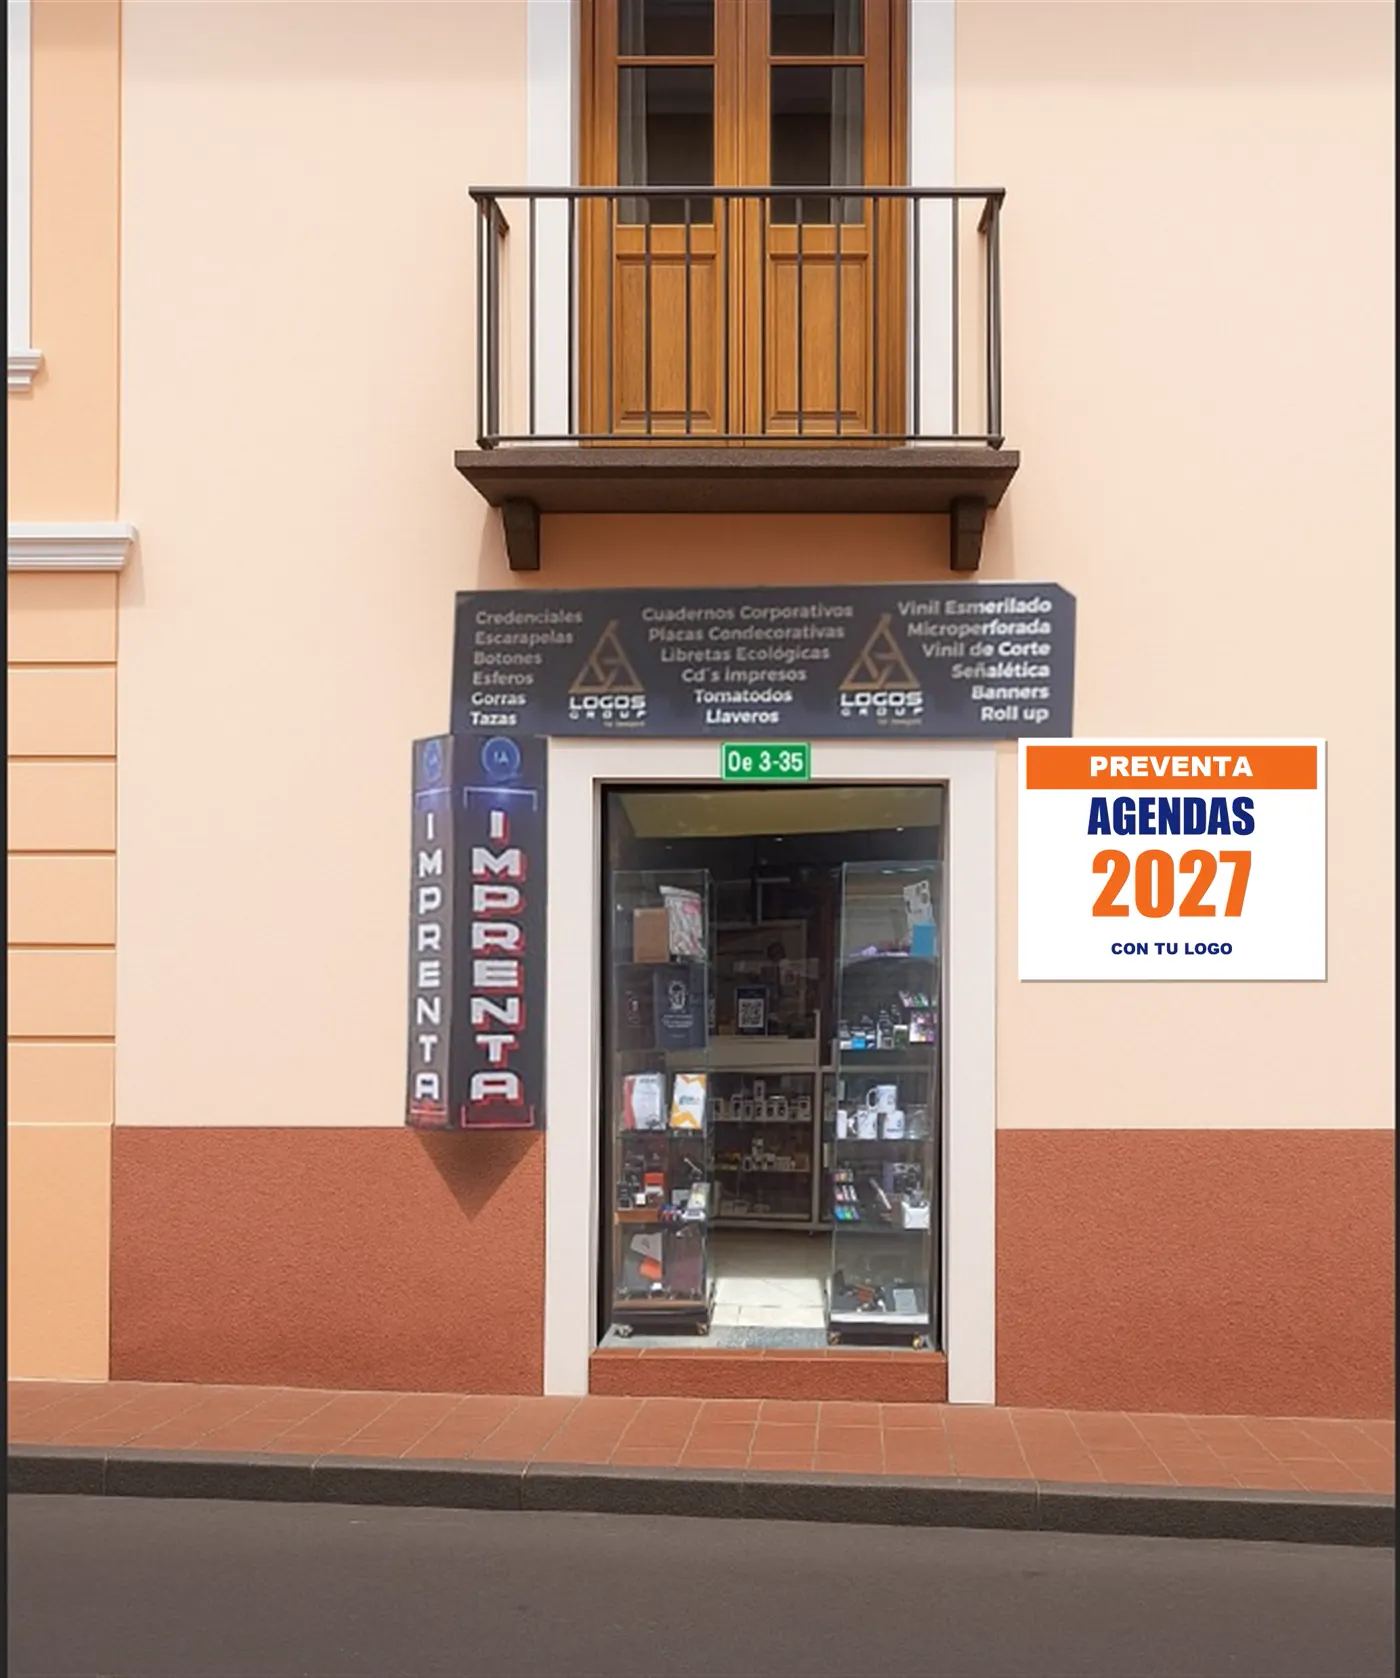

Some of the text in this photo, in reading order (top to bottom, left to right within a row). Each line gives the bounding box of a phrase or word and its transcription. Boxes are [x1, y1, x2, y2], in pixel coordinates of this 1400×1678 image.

[642, 602, 853, 622] Cuadernos Corporativos
[898, 597, 1052, 616] Vinil Esmerilado
[476, 609, 583, 624] Credenciales
[649, 623, 845, 641] Placas Condecorativas
[907, 618, 1051, 637] Microperforada
[475, 630, 574, 647] Escarapelas
[474, 651, 543, 664] Botones
[661, 645, 830, 663] Libretas Ecológicas
[922, 641, 1051, 657] Vinil de Corte
[472, 671, 534, 685] Esferos
[952, 661, 1050, 679] Señalética
[471, 691, 527, 705] Gorras
[694, 688, 793, 703] Tomatodos
[841, 692, 923, 706] LOGOS
[972, 685, 1050, 700] Banners
[569, 695, 646, 710] LOGOS
[470, 711, 517, 725] Tazas
[706, 708, 779, 724] Llaveros
[981, 706, 1049, 724] Roll up
[758, 750, 803, 772] 3-35
[1090, 756, 1253, 777] PREVENTA
[1087, 796, 1255, 835] AGENDAS
[1092, 849, 1252, 918] 2027
[415, 812, 442, 1100] IMPRENTA
[470, 810, 524, 1104] IMPRENTA
[1111, 942, 1233, 955] CON TU LOGO
